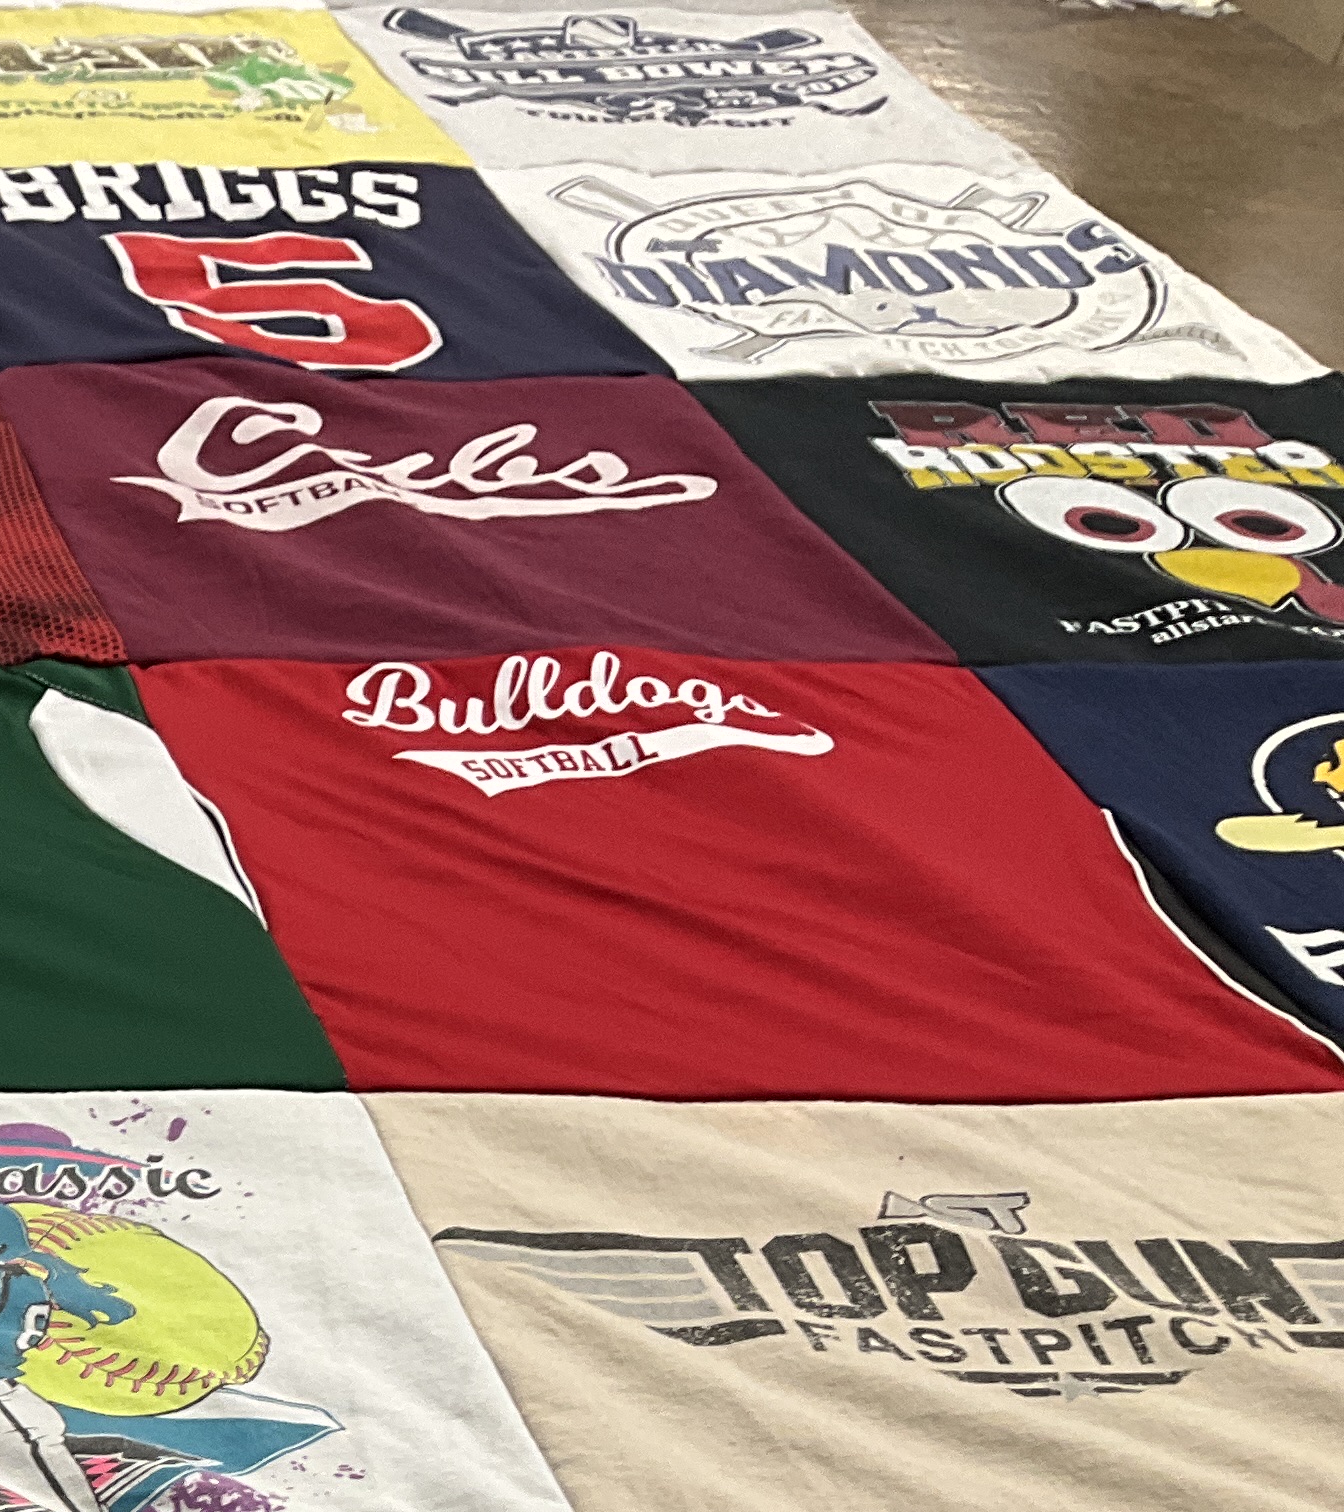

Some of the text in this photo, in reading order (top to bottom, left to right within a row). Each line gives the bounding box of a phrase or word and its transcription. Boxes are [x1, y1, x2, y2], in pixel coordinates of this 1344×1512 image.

[596, 53, 860, 84] BOWEN
[102, 230, 443, 372] 5
[588, 221, 1150, 308] DIAMONDS
[462, 733, 660, 783] SOFTBALL
[689, 1222, 1321, 1326] TOP GUN
[790, 1297, 1300, 1369] FASTPITCH
